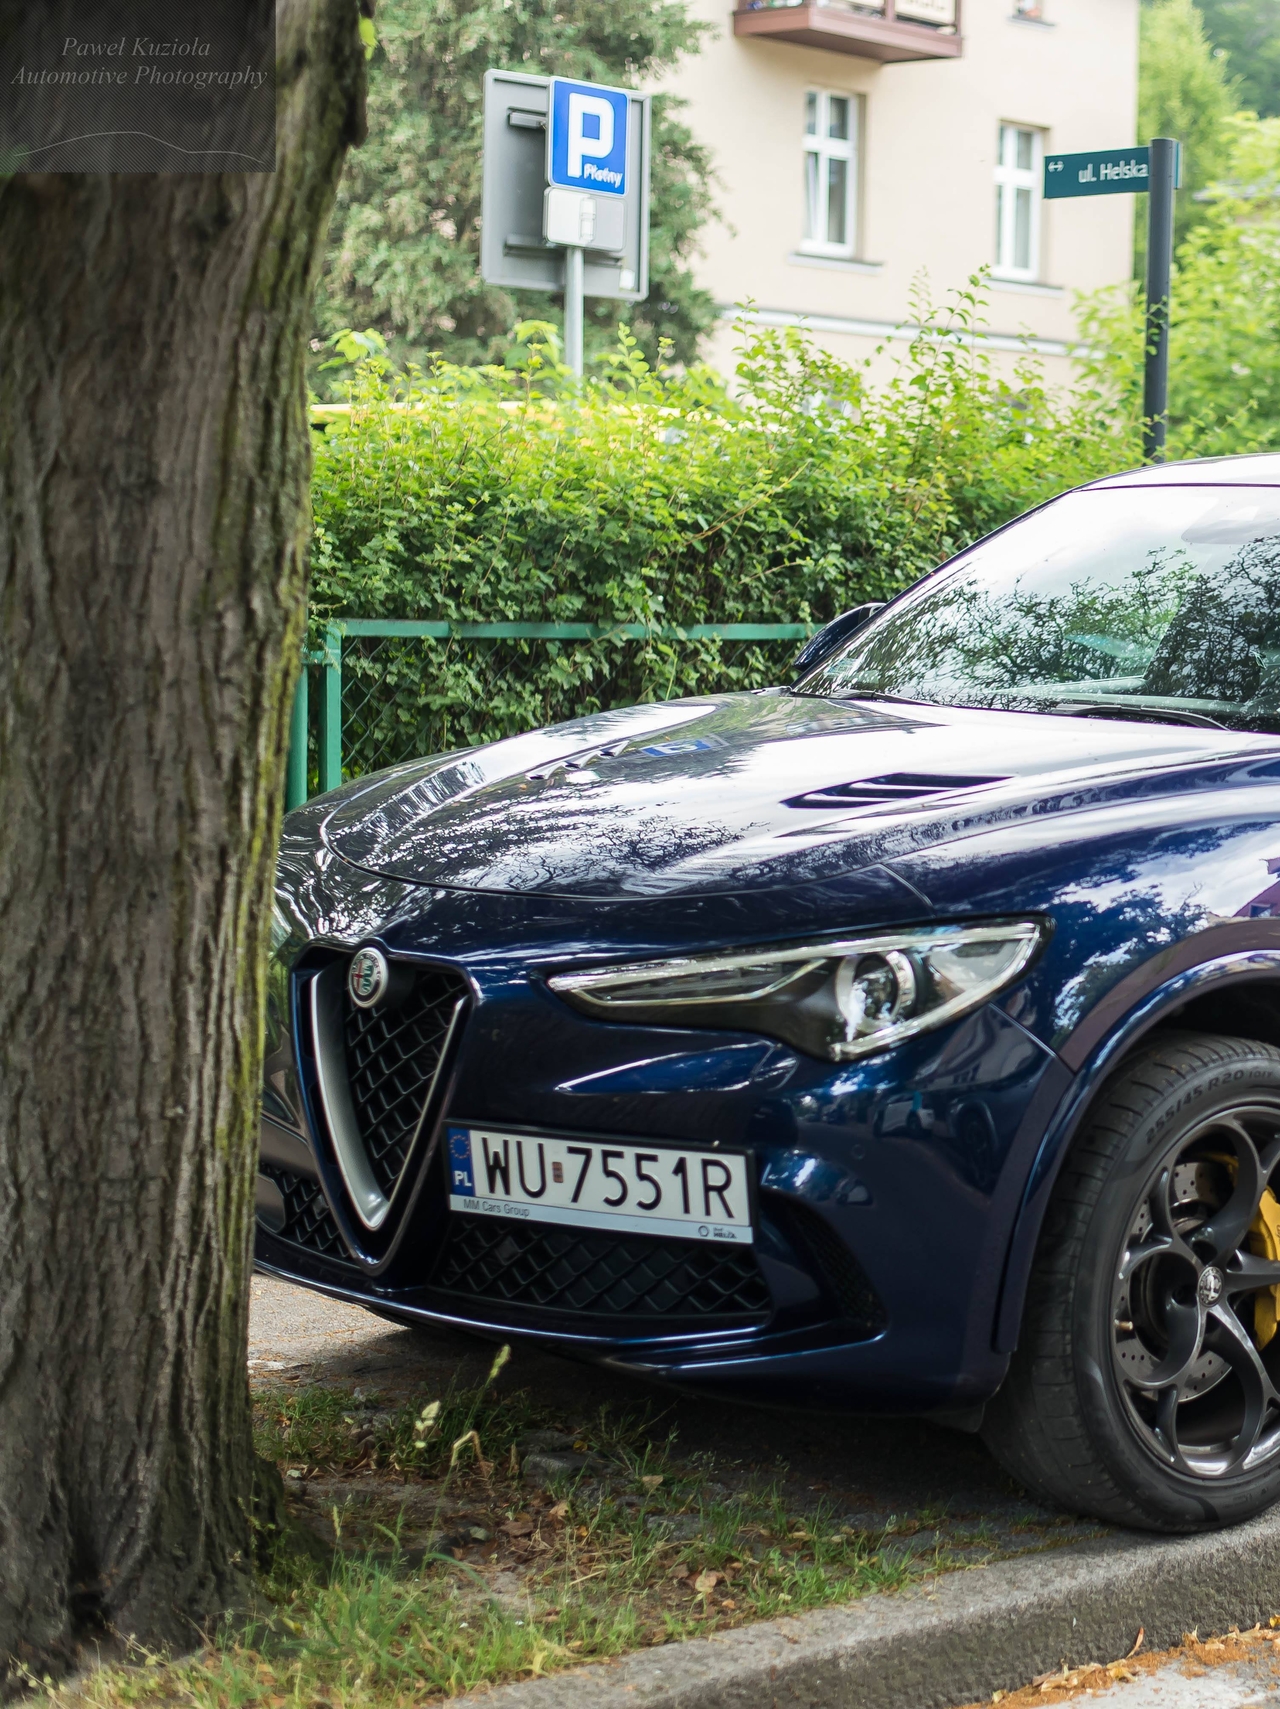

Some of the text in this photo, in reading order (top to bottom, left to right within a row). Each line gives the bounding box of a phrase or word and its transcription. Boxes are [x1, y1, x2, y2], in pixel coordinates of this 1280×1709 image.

[567, 92, 614, 179] P
[1078, 159, 1149, 183] ul. Helska
[1146, 1087, 1204, 1145] 255/45
[1207, 1069, 1245, 1091] R20
[454, 1170, 472, 1187] PL
[481, 1136, 735, 1219] WU 7551R
[462, 1198, 530, 1218] MM Cars Group
